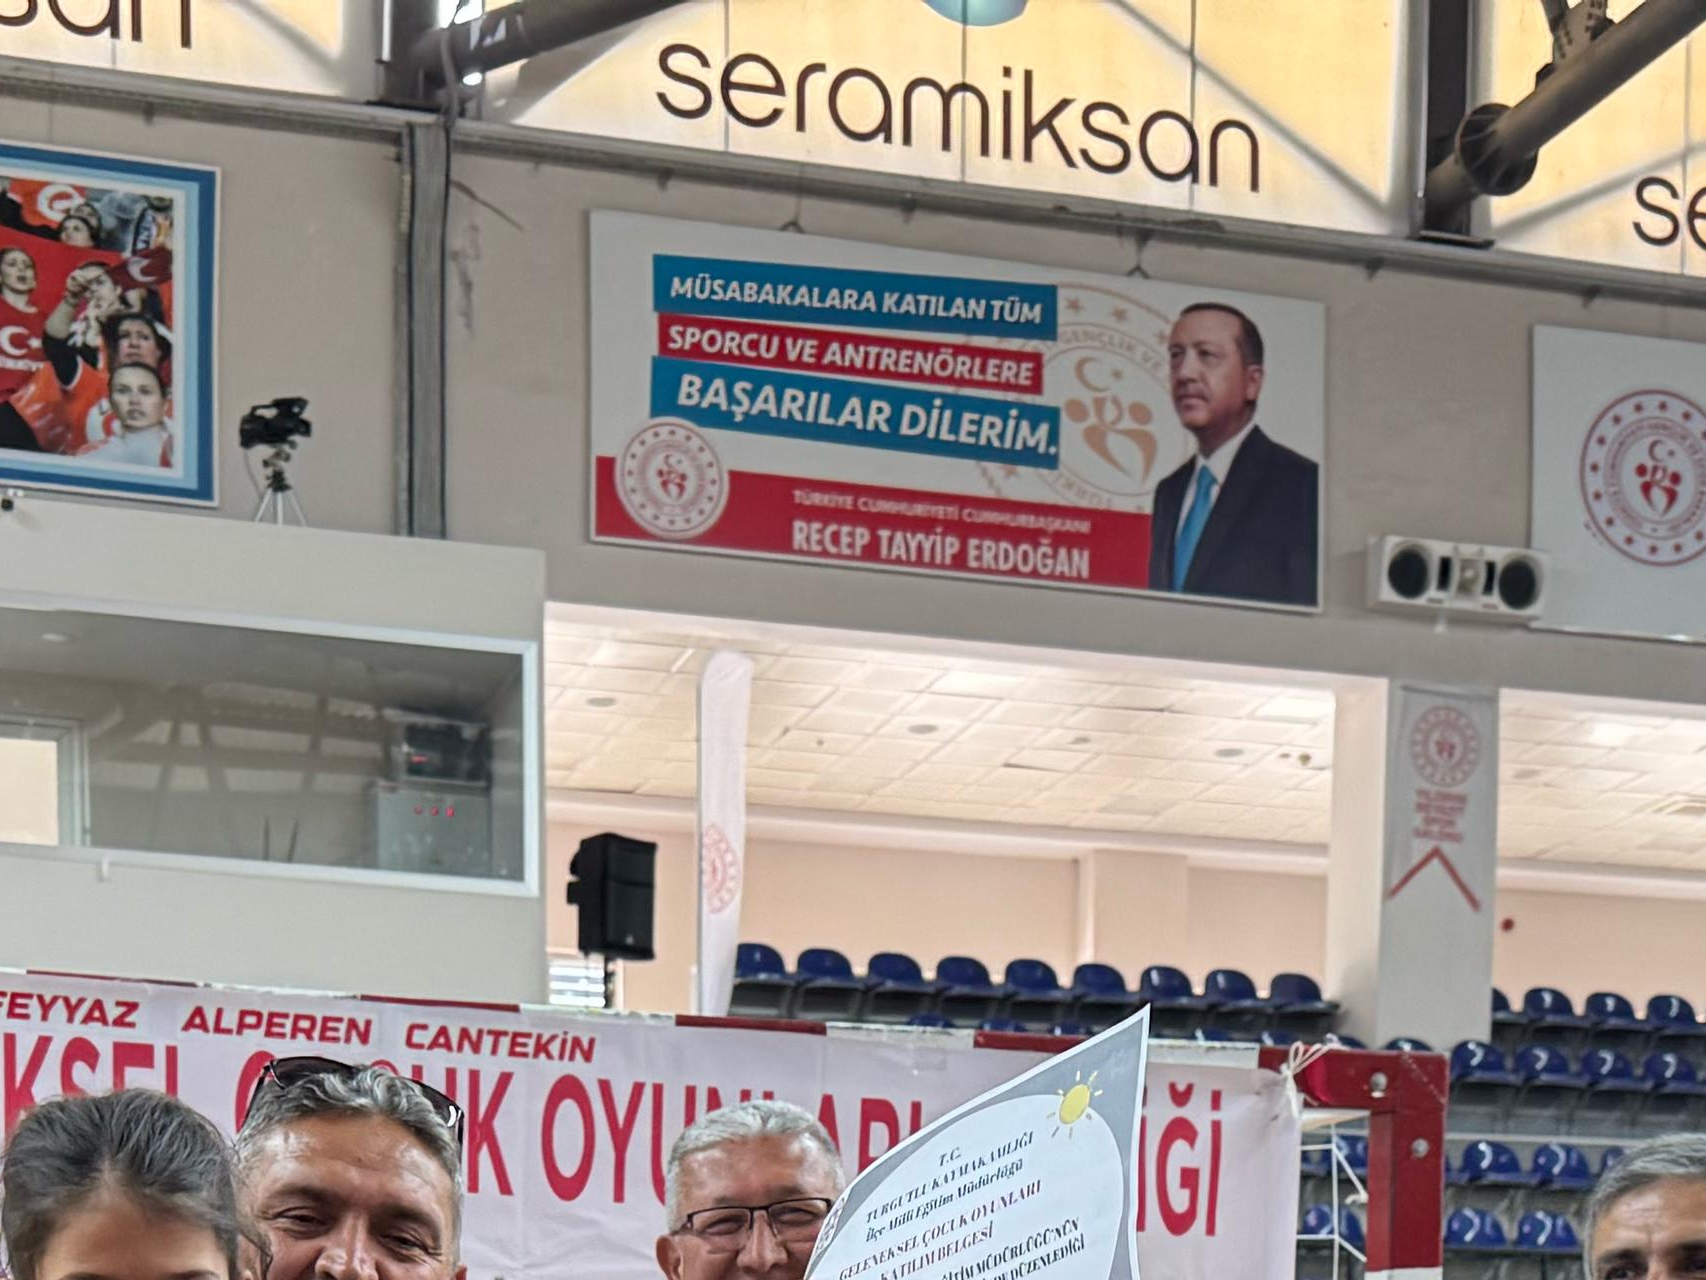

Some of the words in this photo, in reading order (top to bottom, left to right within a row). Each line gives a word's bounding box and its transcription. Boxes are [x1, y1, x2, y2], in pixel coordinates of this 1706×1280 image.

[655, 42, 1260, 193] seramiksan
[670, 274, 878, 313] MÜSABAKALARA
[882, 291, 991, 324] KATILAN
[991, 296, 1043, 326] TÜM
[668, 325, 780, 360] SPORCU
[785, 337, 819, 365] VE
[822, 337, 1036, 387] ANTRENÖRLERE
[678, 373, 893, 435] BAŞARILAR
[899, 396, 1060, 457] DİLERİM.
[793, 519, 869, 556] RECEP
[878, 526, 961, 568] TAYYİP
[967, 536, 1091, 580] ERDOĞAN
[181, 1005, 372, 1046] ALPEREN
[405, 1022, 596, 1064] CANTEKİN
